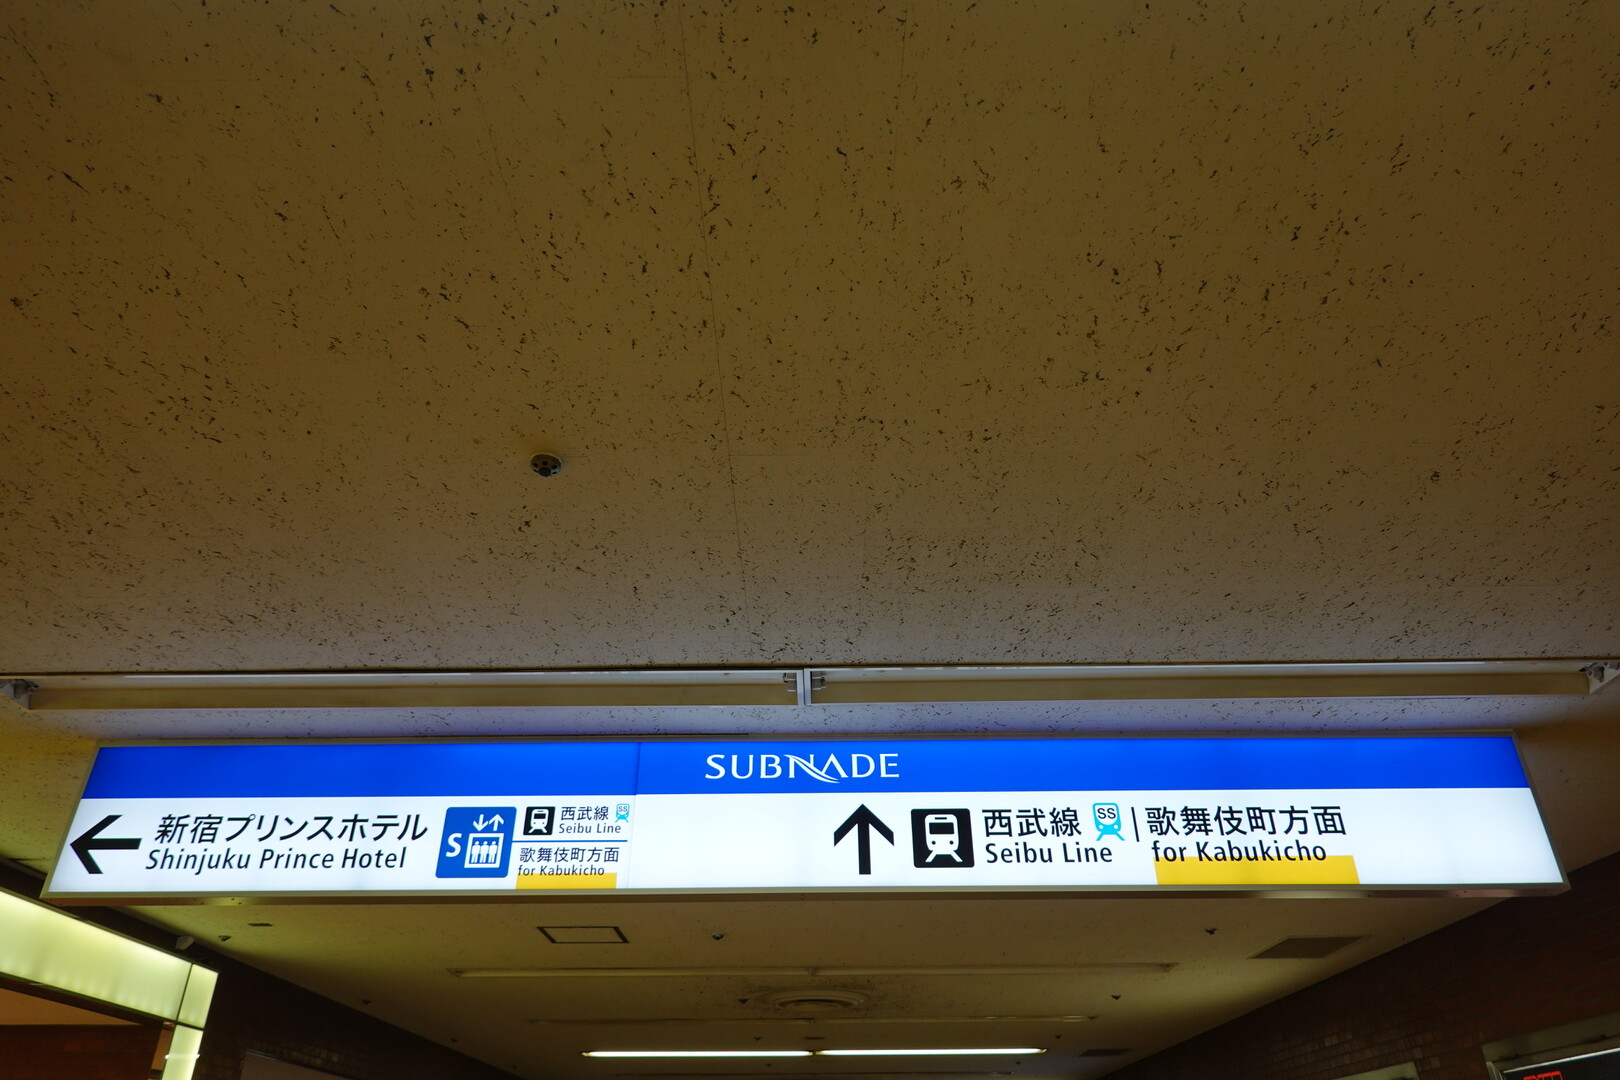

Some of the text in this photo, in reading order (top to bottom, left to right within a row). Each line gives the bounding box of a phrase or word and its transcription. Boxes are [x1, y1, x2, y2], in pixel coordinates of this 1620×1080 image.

[704, 753, 900, 784] SUBNADE
[560, 806, 609, 821] 西武線
[617, 805, 628, 813] SS
[1097, 807, 1117, 820] SS
[1145, 805, 1347, 836] 歌舞伎町方面
[154, 813, 428, 844] 新宿プリンスホテル
[558, 823, 622, 834] Seibu Line
[981, 806, 1082, 838] 西武線
[445, 833, 462, 857] S
[519, 847, 620, 863] 歌舞伎町方面
[985, 841, 1113, 864] Seibu Line
[1151, 839, 1327, 862] for Kabukicho
[145, 846, 407, 876] Shinjuku Prince Hotel
[517, 864, 605, 876] for Kabukicho
